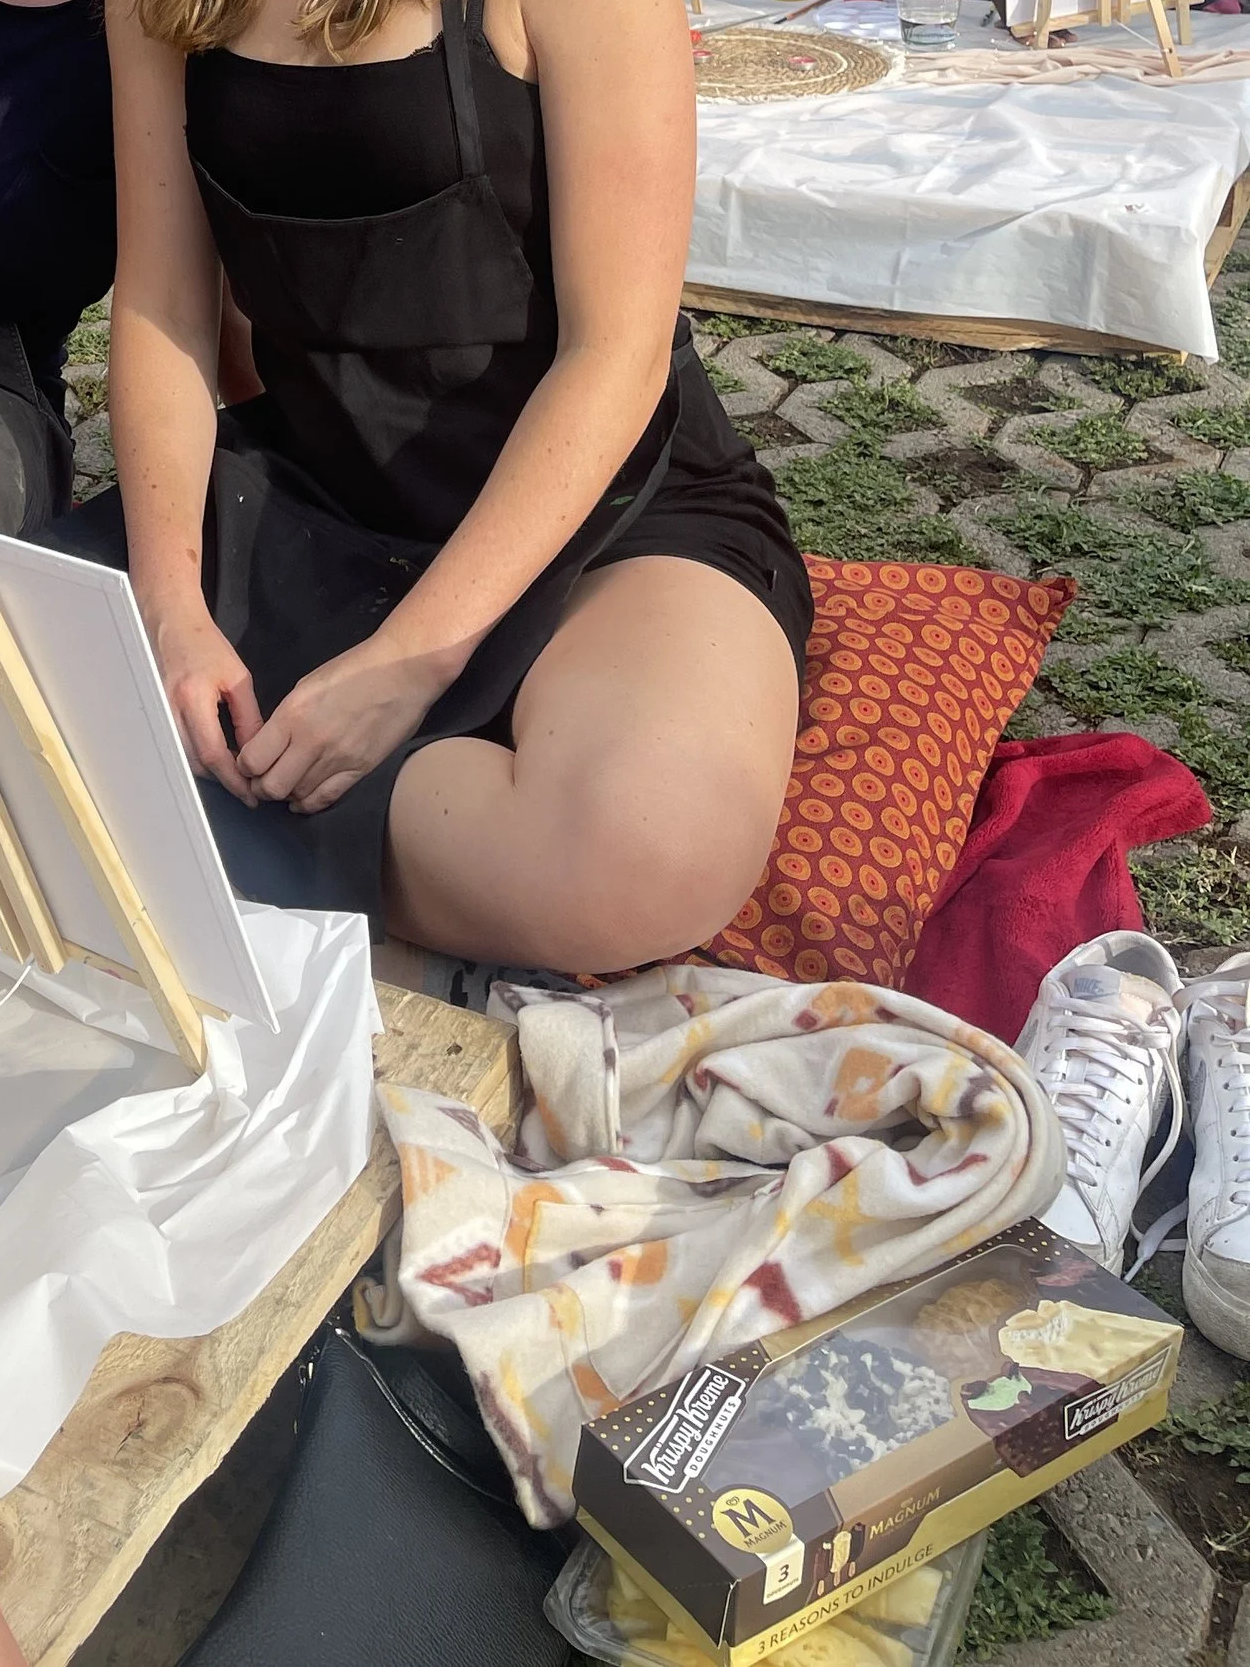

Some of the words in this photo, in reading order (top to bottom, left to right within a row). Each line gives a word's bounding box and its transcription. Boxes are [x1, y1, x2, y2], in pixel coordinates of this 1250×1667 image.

[1074, 977, 1103, 994] NIKE
[641, 1414, 702, 1485] Krispy
[675, 1369, 730, 1431] Kreme
[1070, 1384, 1120, 1431] Krispy
[689, 1401, 737, 1472] DOUGHNUTS
[721, 1498, 776, 1539] M
[743, 1520, 787, 1548] MAGNUM
[870, 1486, 941, 1540] MAGNUM
[778, 1564, 789, 1583] 3
[758, 1640, 767, 1655] 3
[770, 1597, 840, 1648] REASONS
[843, 1585, 864, 1604] TO
[867, 1543, 935, 1591] INDULGE
